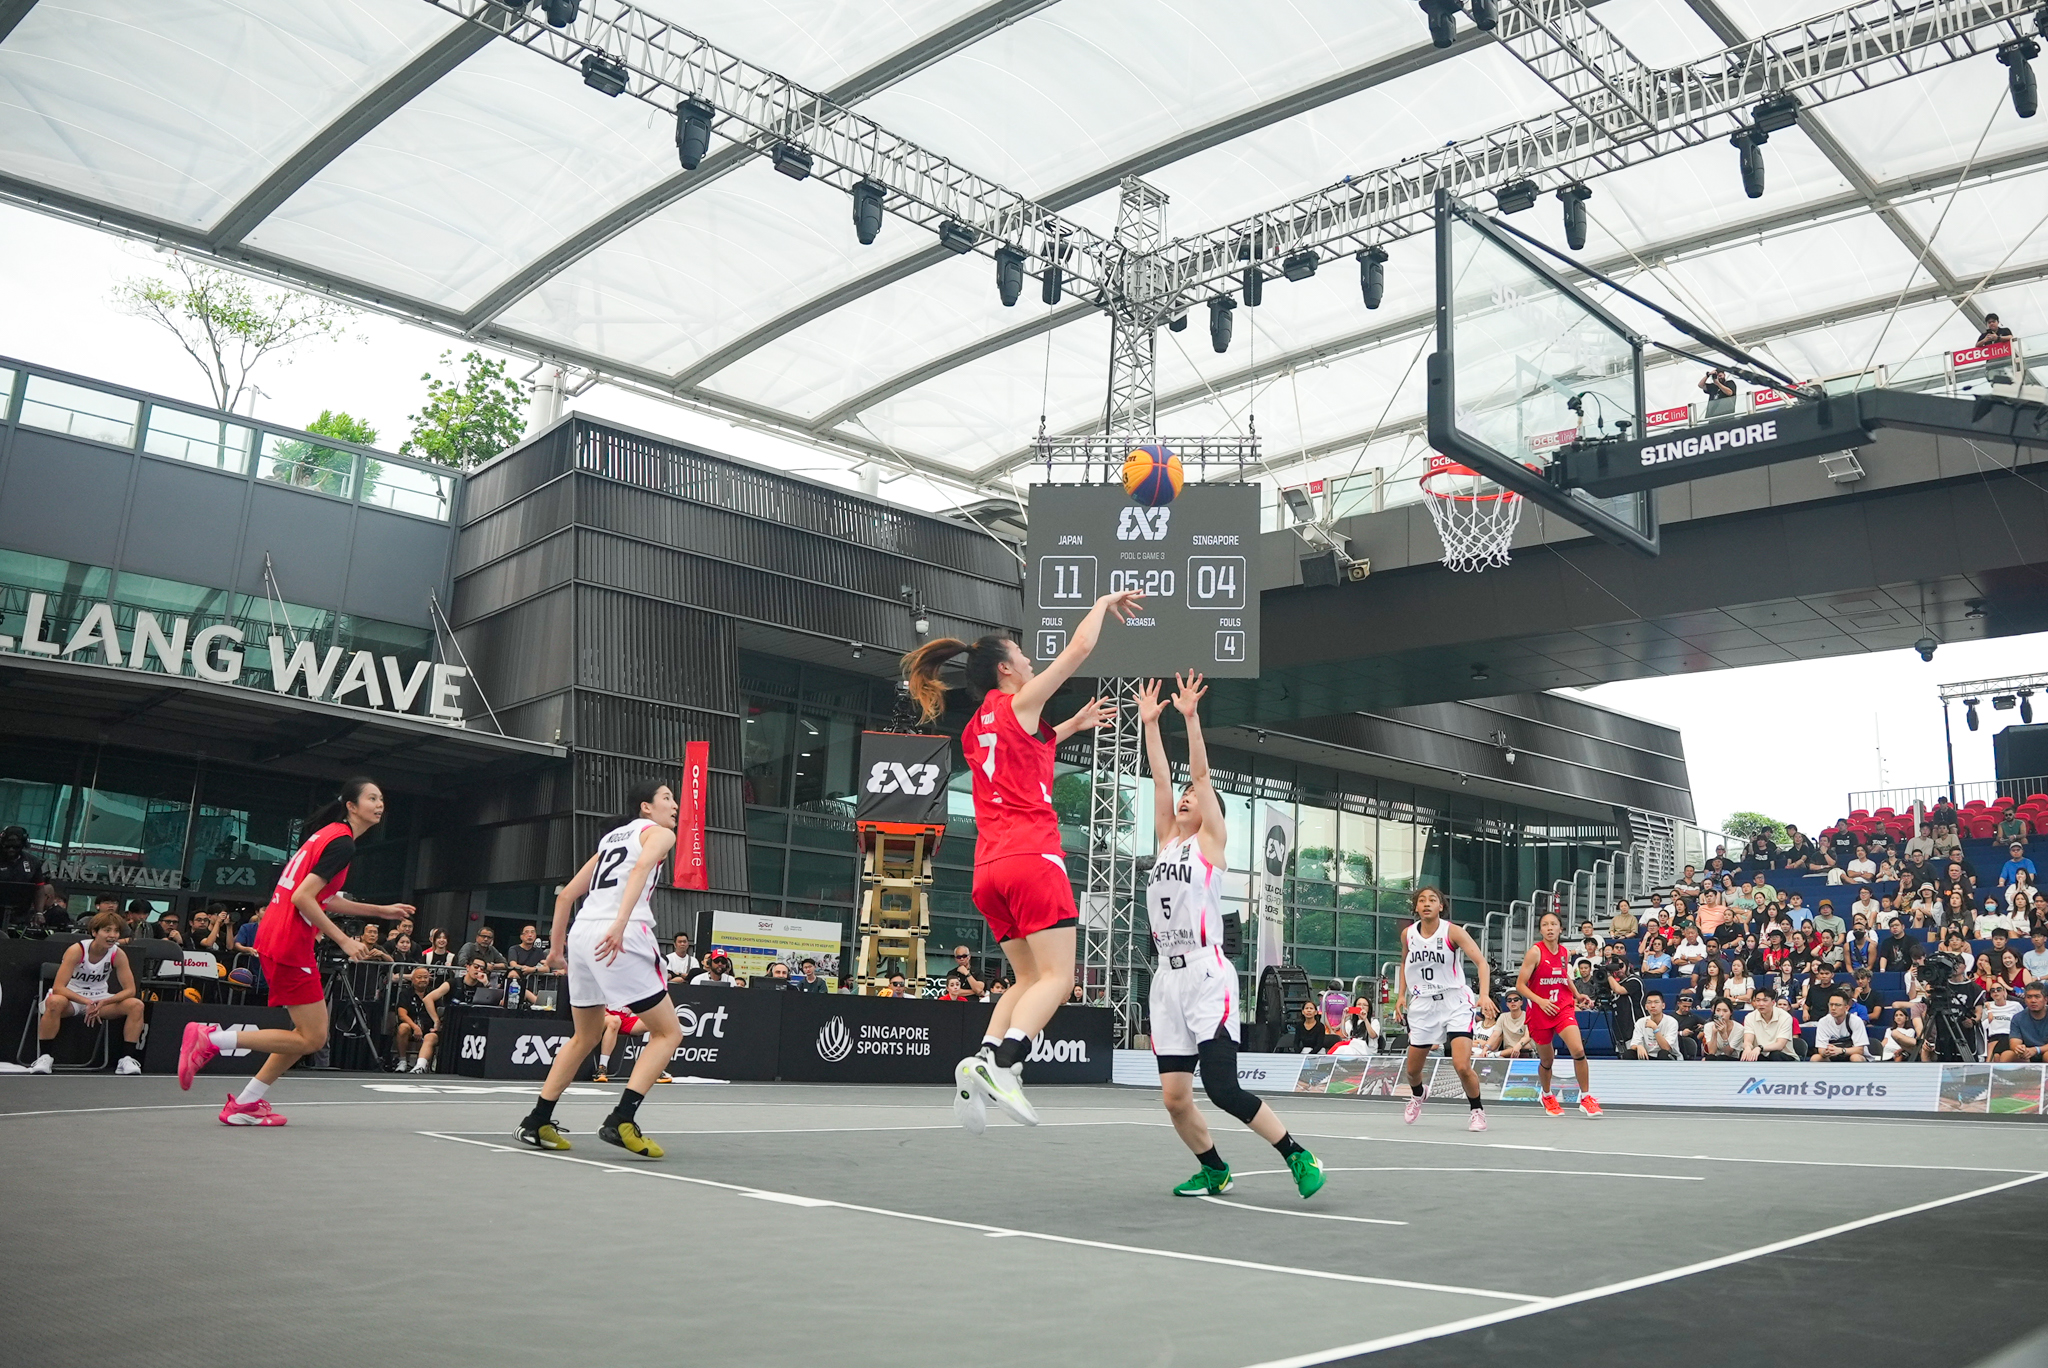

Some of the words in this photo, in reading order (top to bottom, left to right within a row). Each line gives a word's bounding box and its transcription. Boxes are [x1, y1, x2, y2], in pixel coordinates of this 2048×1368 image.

[1955, 348, 1989, 362] OCBC
[1991, 346, 2009, 356] link
[1757, 390, 1783, 402] OCB
[1671, 409, 1686, 420] link
[1533, 434, 1559, 447] OCBC
[1561, 430, 1575, 442] link
[1641, 420, 1777, 466] SINGAPORE
[1116, 507, 1171, 540] 3X3
[1058, 535, 1083, 545] JAPAN
[1192, 535, 1239, 545] SINGAPORE
[1120, 552, 1136, 560] POOL
[1136, 552, 1142, 560] C
[1143, 552, 1159, 560] GAME
[1160, 552, 1165, 560] 3
[1053, 565, 1082, 598] 11
[1110, 570, 1175, 596] 05:20
[1197, 565, 1236, 598] 04
[1041, 617, 1063, 626] FOULS
[1126, 617, 1155, 627] 3X3ASIA
[1219, 617, 1241, 627] FOULS
[1046, 635, 1057, 655] 5
[1224, 636, 1235, 655] 4
[0, 593, 245, 683] LANG
[268, 635, 466, 719] WAVE
[977, 733, 998, 783] 7
[866, 762, 940, 796] 3X3
[107, 864, 184, 890] WAVE
[278, 848, 307, 890] 11
[591, 846, 628, 891] 12
[1147, 862, 1192, 887] JAPAN
[1160, 897, 1172, 920] 5
[174, 957, 208, 967] Wlson
[1409, 950, 1445, 964] JAPAN
[71, 971, 108, 983] JAPAN
[1420, 967, 1434, 981] 10
[860, 1025, 930, 1040] SINGAPORE
[623, 1046, 719, 1062] SIAPORE
[857, 1041, 903, 1055] SPORTS
[906, 1042, 931, 1056] HUB
[1024, 1028, 1086, 1063] lson
[1236, 1068, 1267, 1080] orts
[1737, 1077, 1808, 1095] Avant
[1814, 1081, 1887, 1099] Sports
